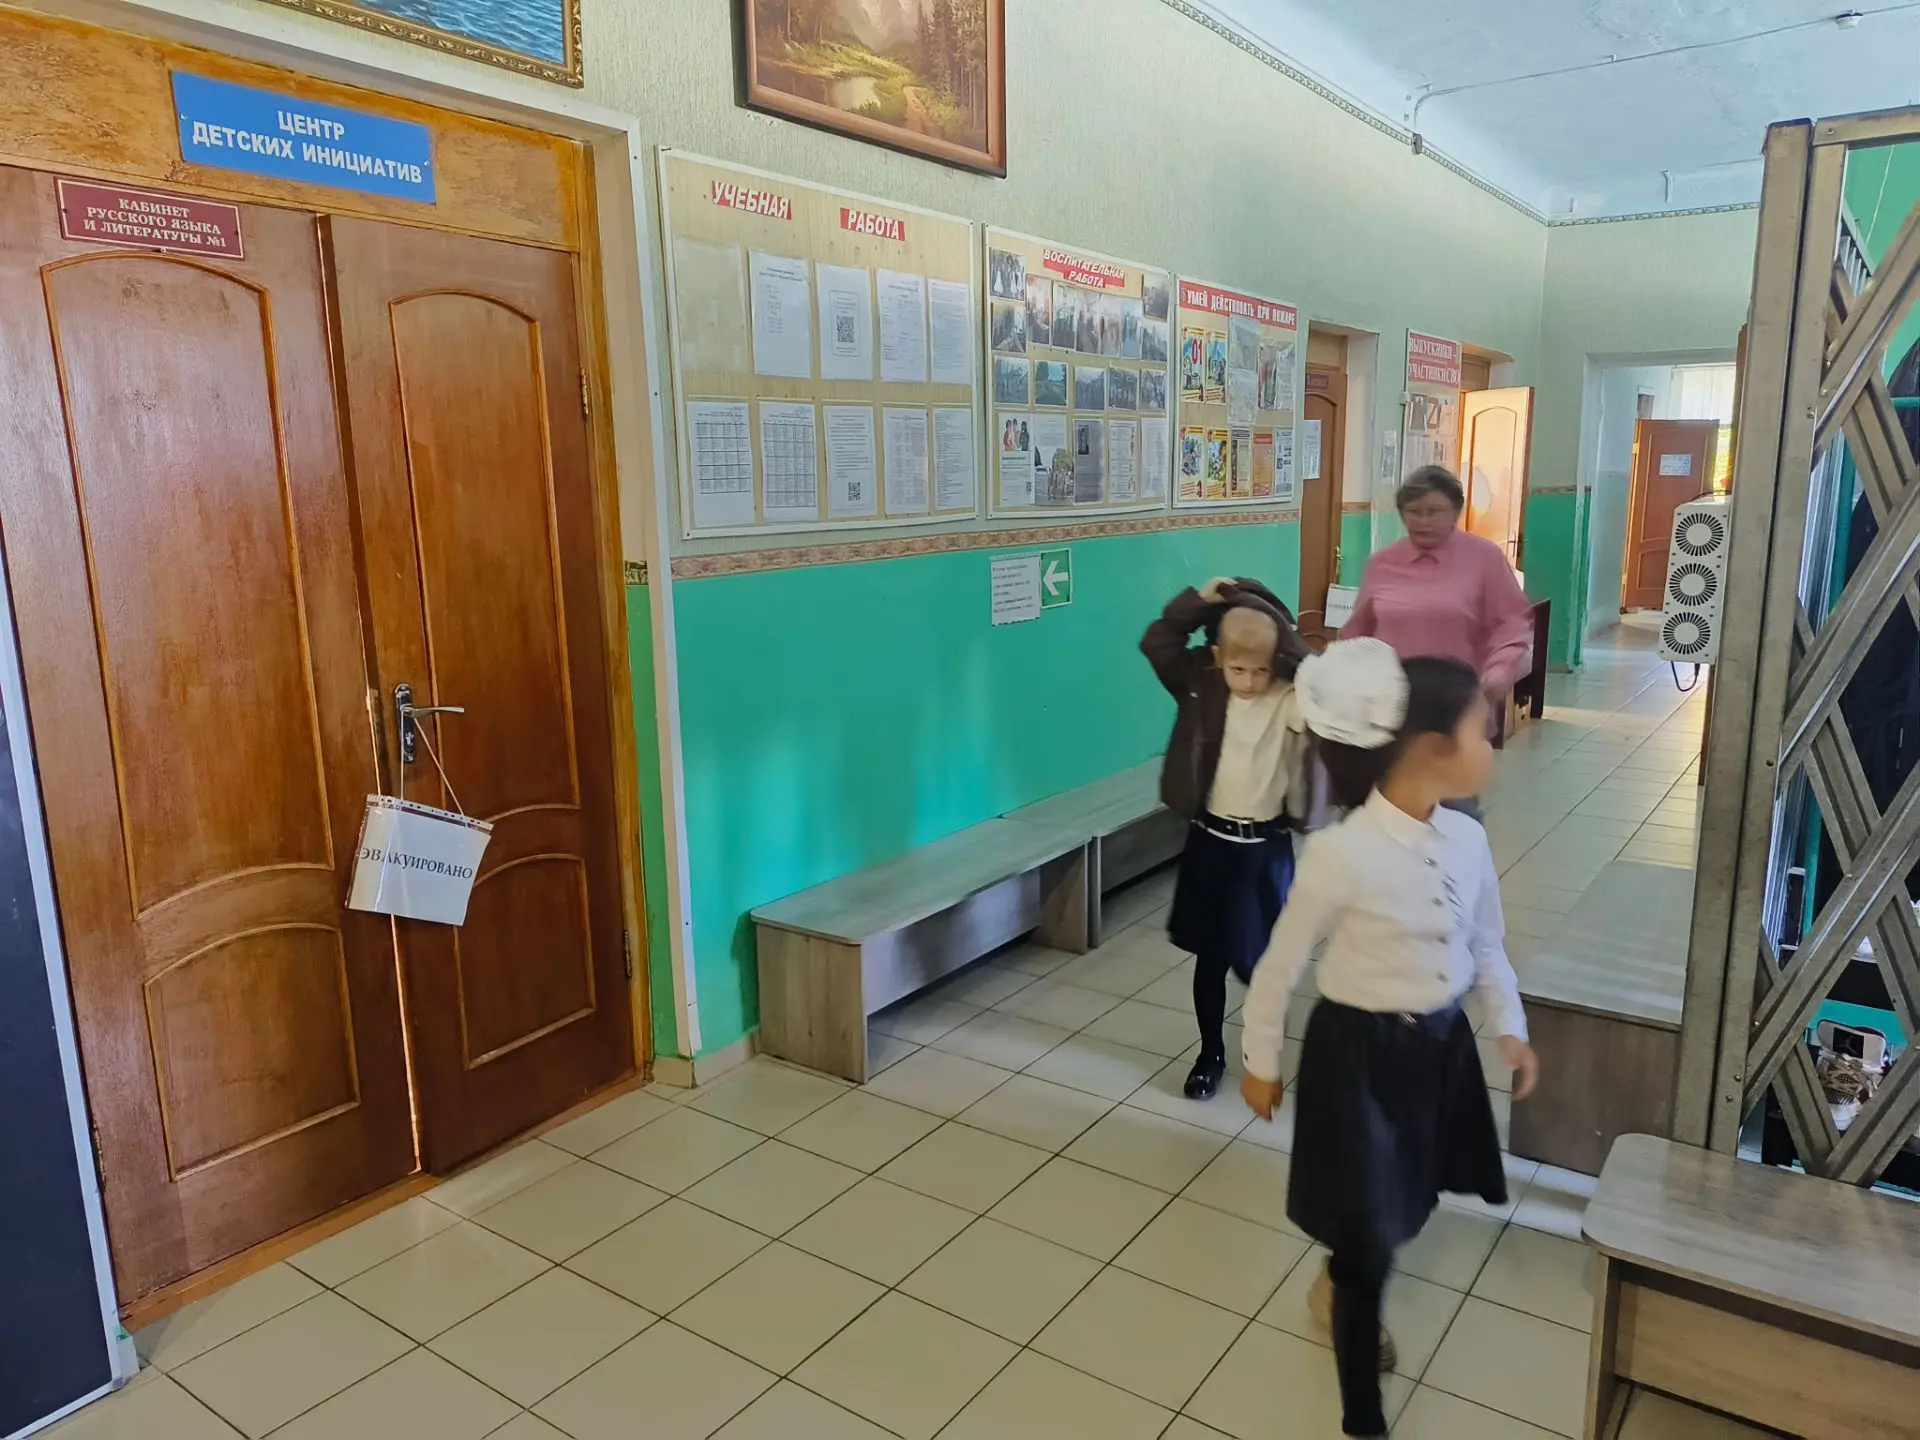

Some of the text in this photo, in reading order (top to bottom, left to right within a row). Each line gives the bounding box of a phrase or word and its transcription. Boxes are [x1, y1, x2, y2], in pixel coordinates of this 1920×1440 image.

[277, 110, 345, 144] ЦЕНТР
[192, 120, 423, 184] ДЕТСКИХ ИНИЦИАТИВ
[86, 206, 222, 235] РУССКОГО ЯЗЫКА
[118, 198, 190, 218] КАБИНЕТ
[713, 180, 900, 240] УЧЕБНАЯ РАБОТА
[83, 219, 227, 248] И ЛИТЕРАТУРЫ №1
[1043, 249, 1124, 280] ВОСПИТАТЕЛЬНАЯ
[1068, 270, 1104, 288] РАБОТА
[1187, 290, 1208, 308] УМЕЙ
[360, 847, 473, 879] ЭВАКУИРОВАНО
